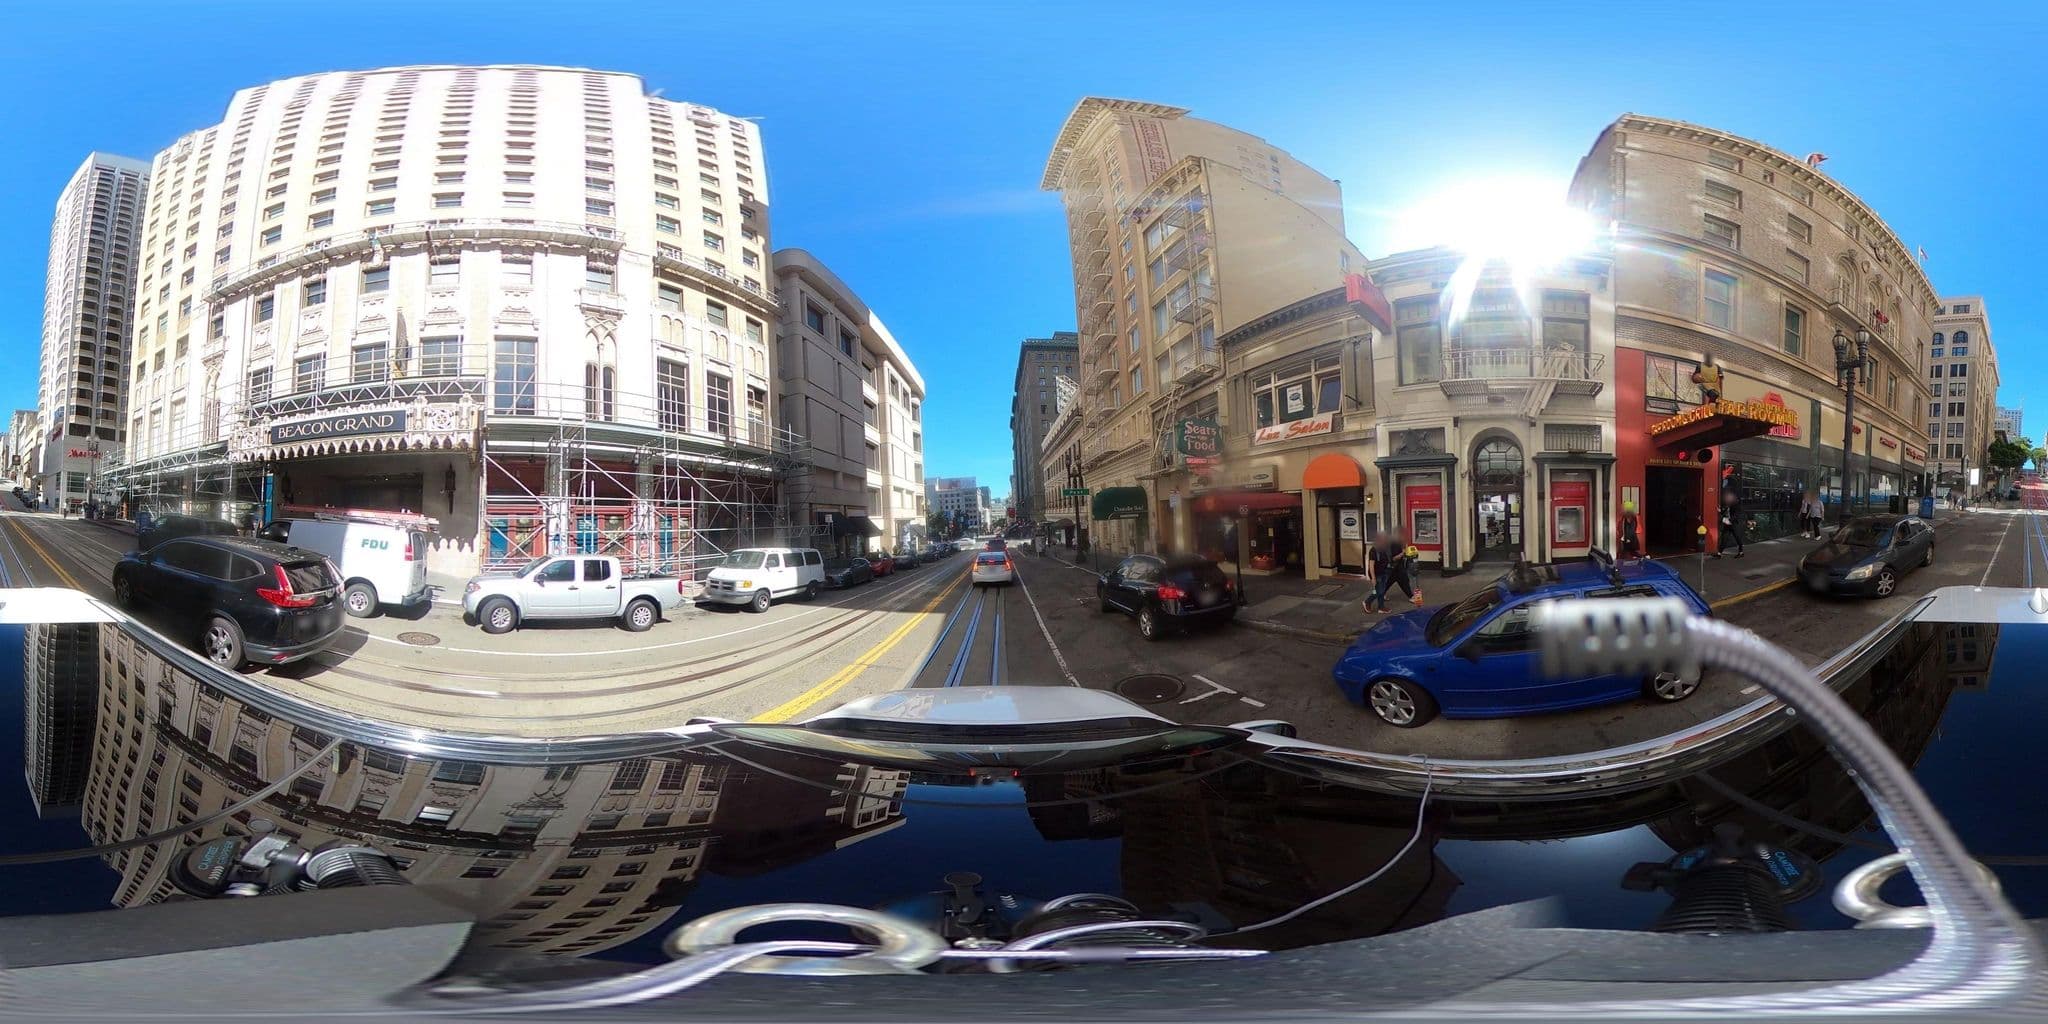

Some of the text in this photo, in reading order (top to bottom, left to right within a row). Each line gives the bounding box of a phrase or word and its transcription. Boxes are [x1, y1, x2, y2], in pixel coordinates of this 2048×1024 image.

[1719, 399, 1745, 417] TAP
[278, 415, 394, 439] BEACON GRAND
[1184, 421, 1217, 436] Sears
[1256, 420, 1330, 442] Lux Salon
[1183, 435, 1216, 451] Food
[361, 538, 389, 550] FDU
